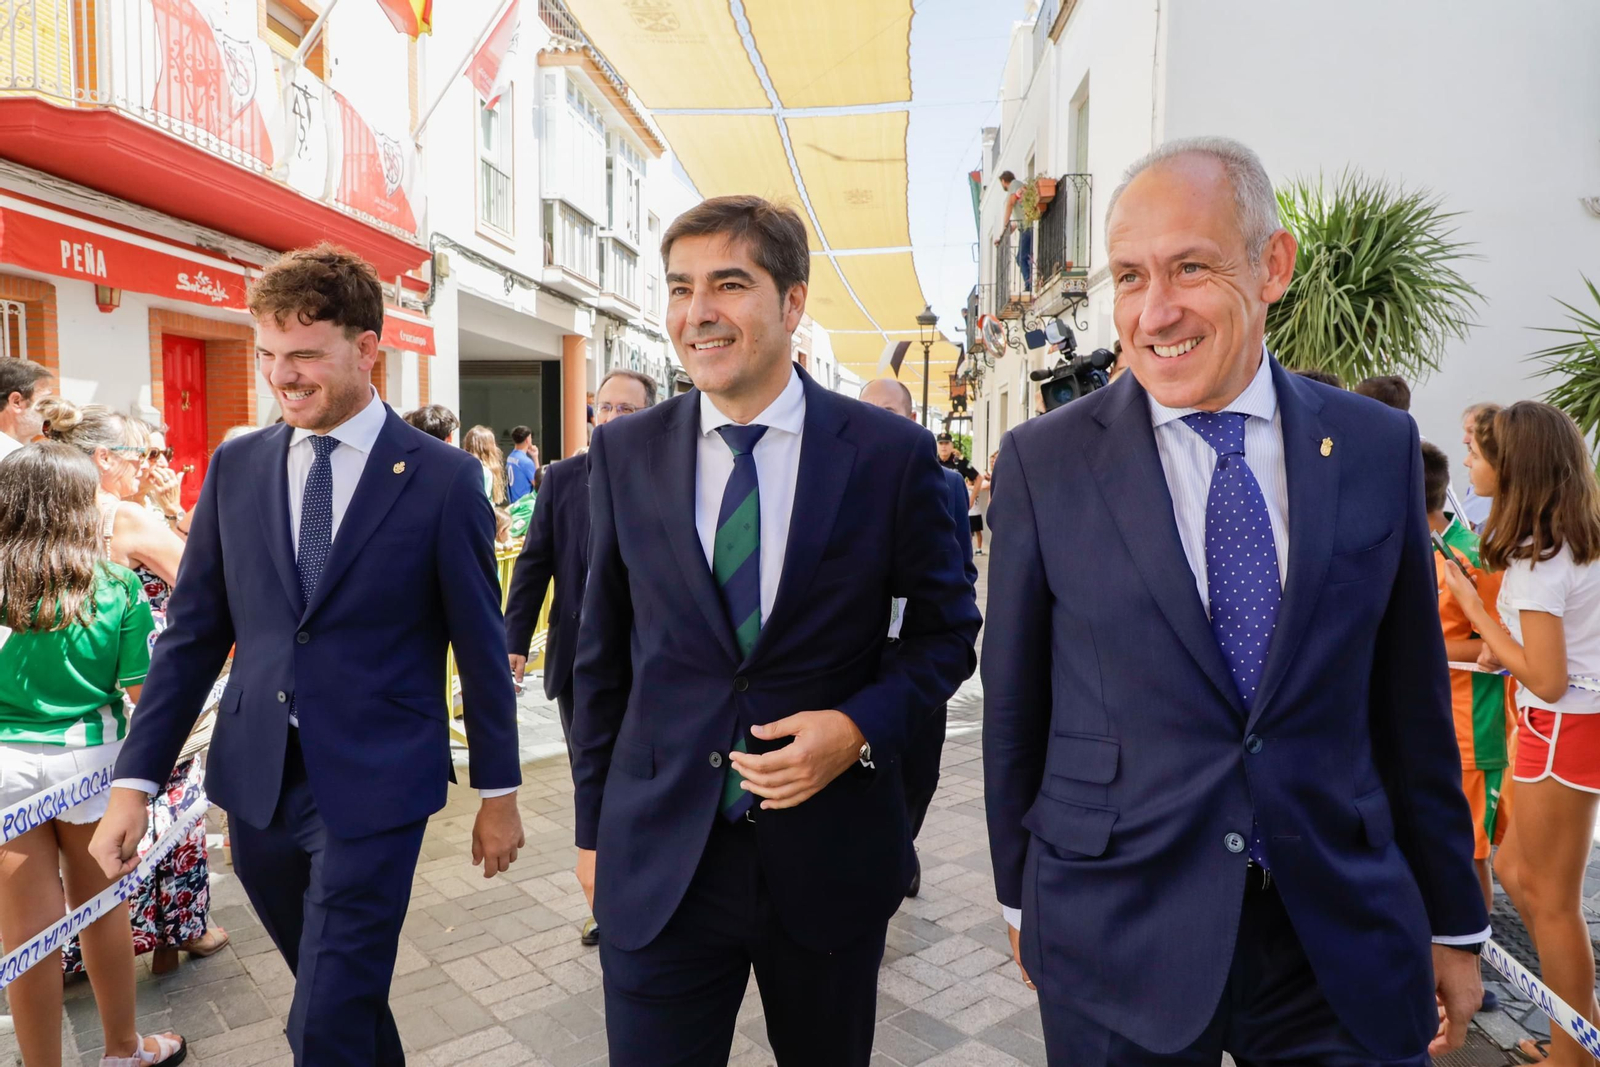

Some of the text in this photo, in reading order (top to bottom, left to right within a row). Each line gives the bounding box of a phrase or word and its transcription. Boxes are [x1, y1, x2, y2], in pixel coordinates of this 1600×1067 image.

[60, 239, 107, 279] PEÑA
[3, 788, 69, 842] POLICIA
[1513, 965, 1564, 1027] LOCAL
